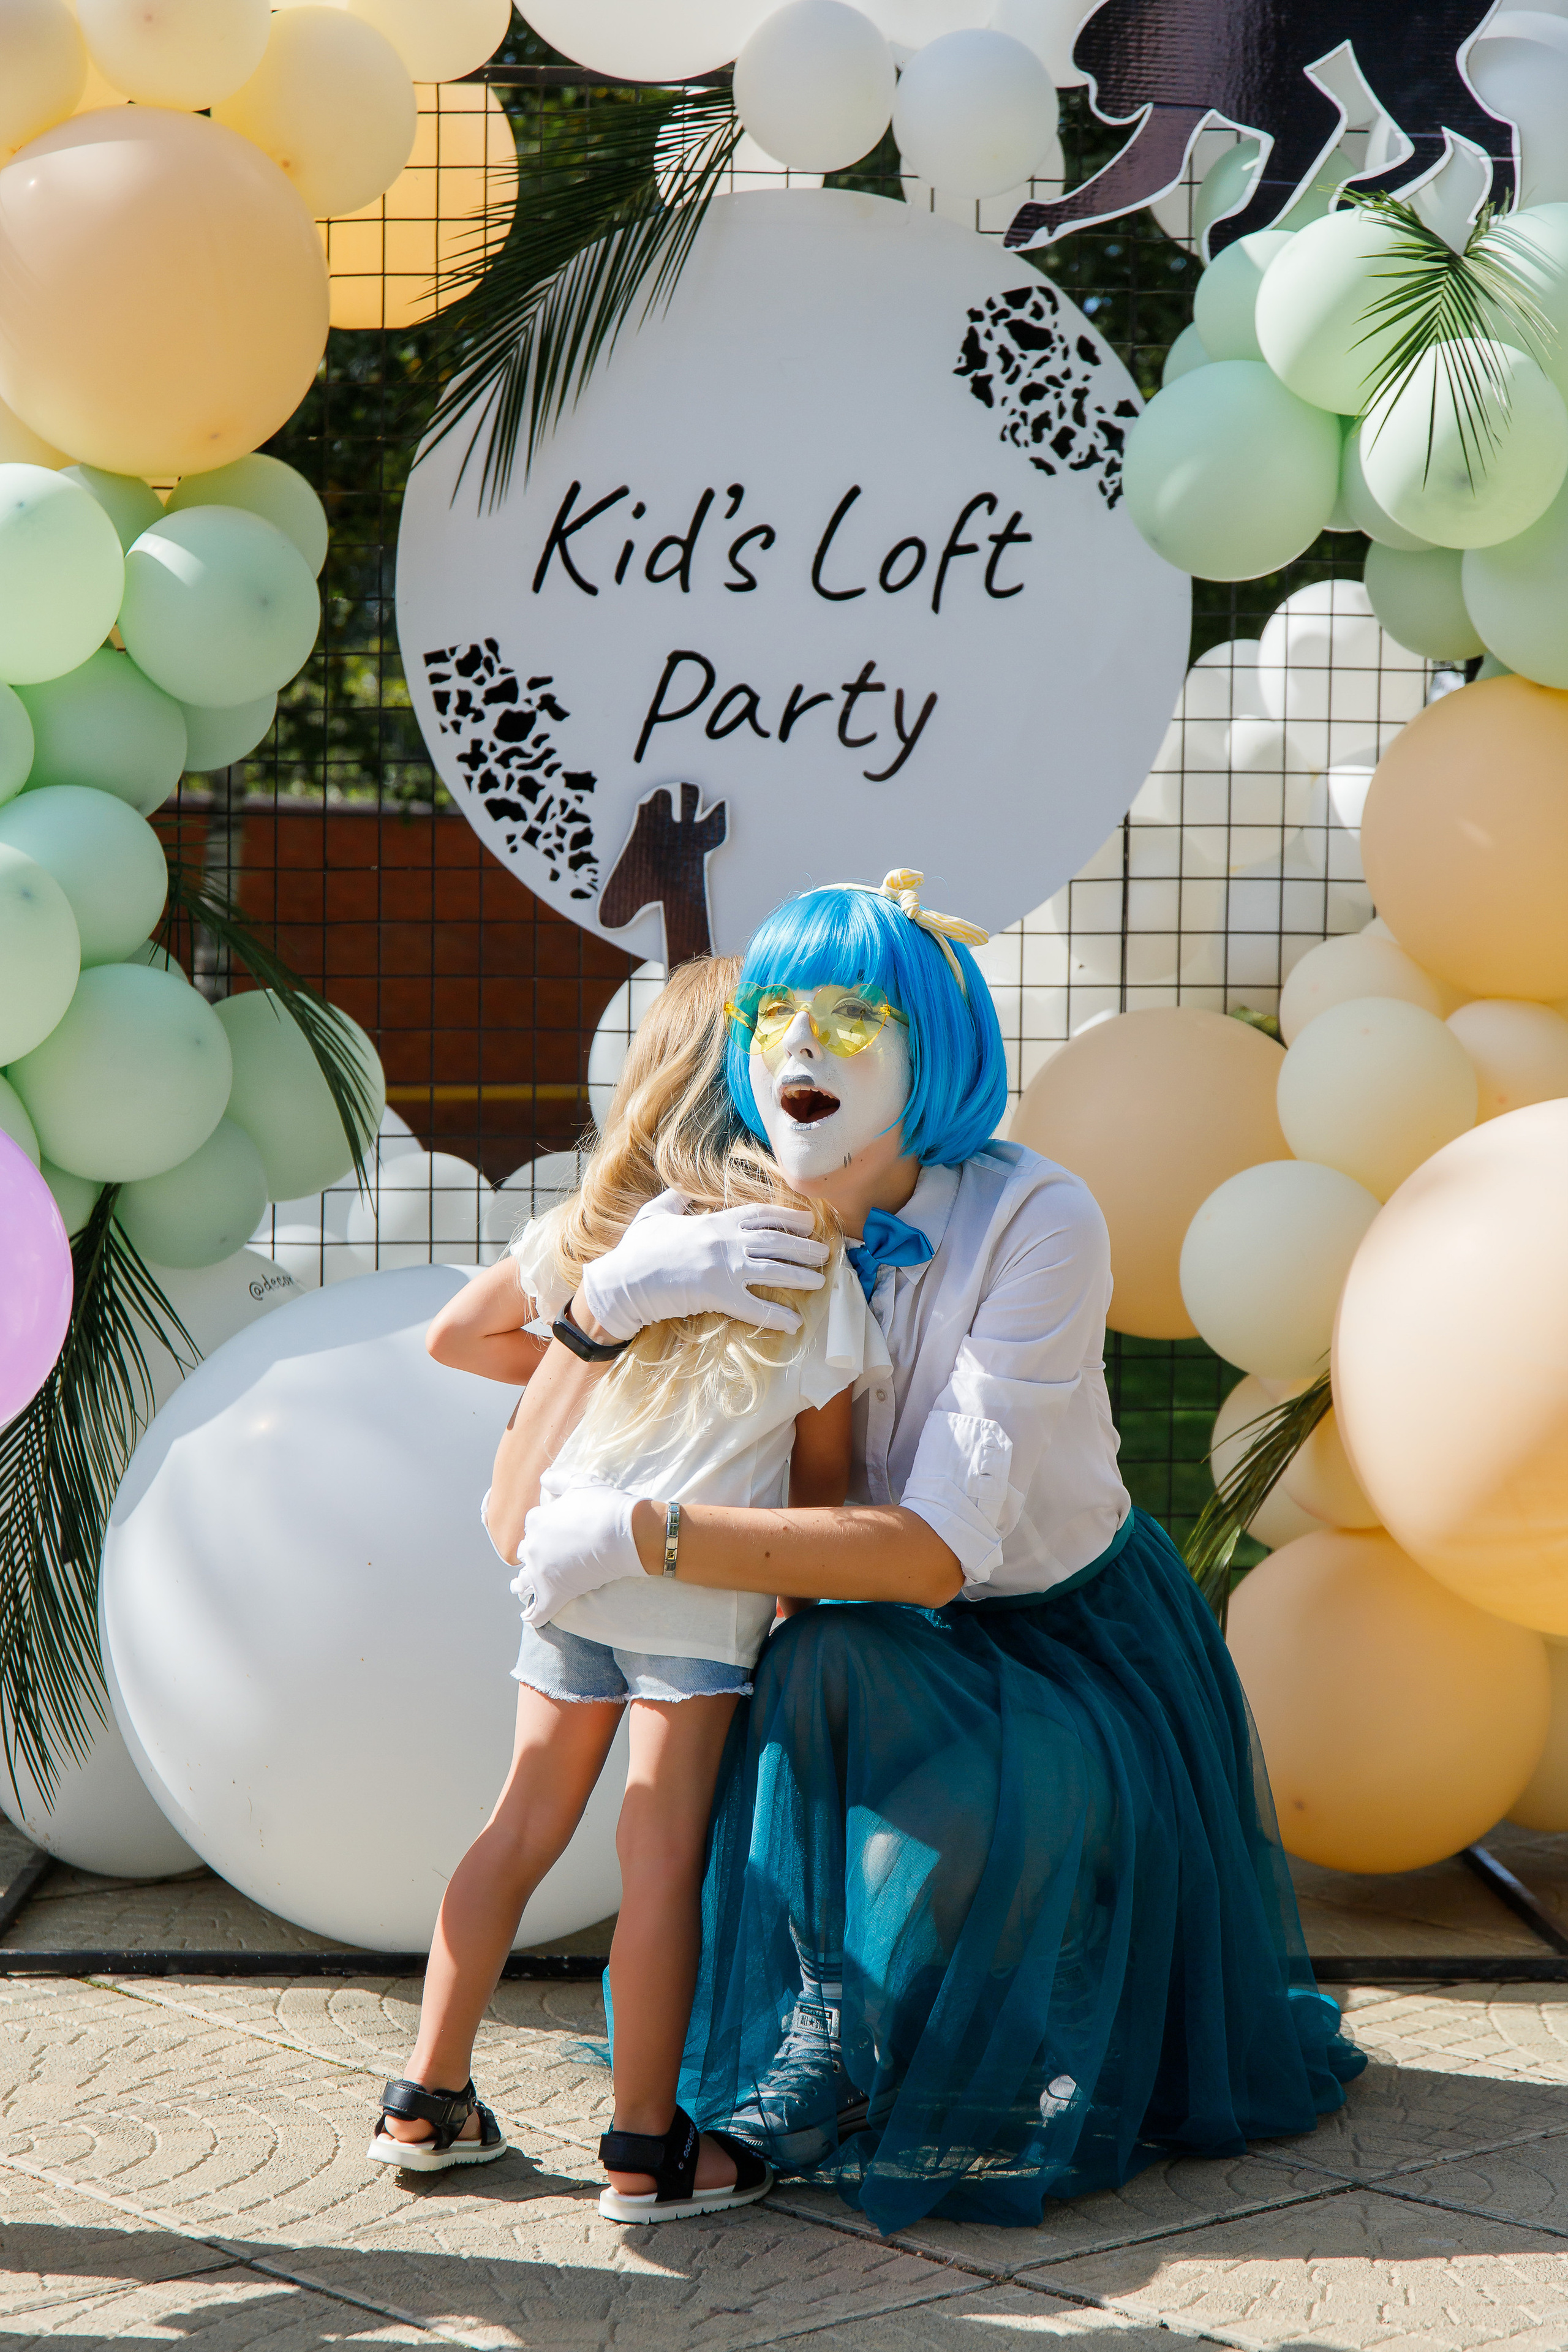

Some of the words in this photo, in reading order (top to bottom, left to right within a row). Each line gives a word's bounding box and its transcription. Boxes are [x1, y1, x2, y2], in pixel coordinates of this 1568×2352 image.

[532, 480, 777, 597] Kid's
[812, 484, 1033, 615] Loft
[633, 650, 939, 782] Party
[802, 2007, 831, 2018] CONVERE
